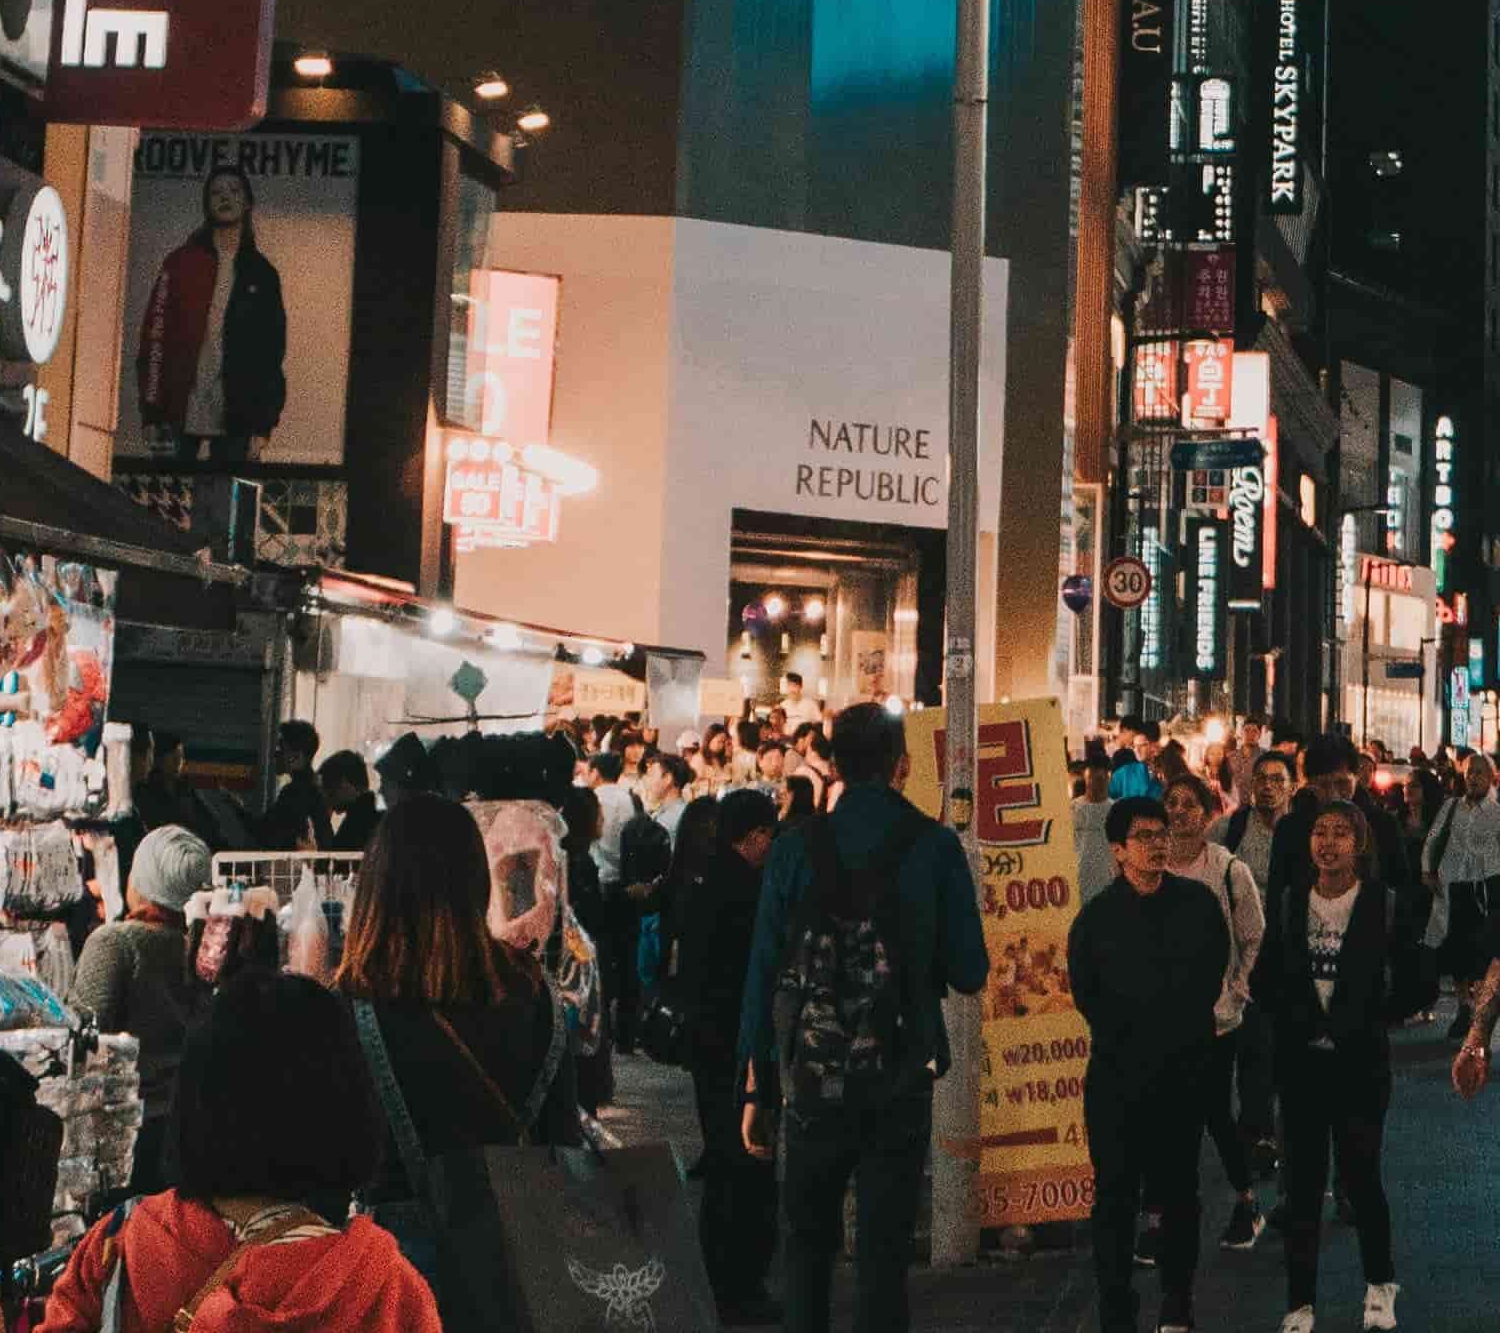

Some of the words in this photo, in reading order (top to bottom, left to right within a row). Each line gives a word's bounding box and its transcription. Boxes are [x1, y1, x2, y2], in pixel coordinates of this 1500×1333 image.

[1271, 64, 1300, 205] SKYPARK
[808, 417, 932, 460] NATURE
[795, 463, 942, 507] REPUBLIC
[1228, 465, 1264, 567] Roem
[1197, 527, 1218, 577] LINE
[1113, 571, 1143, 588] 30
[1196, 578, 1217, 670] FRIENDS
